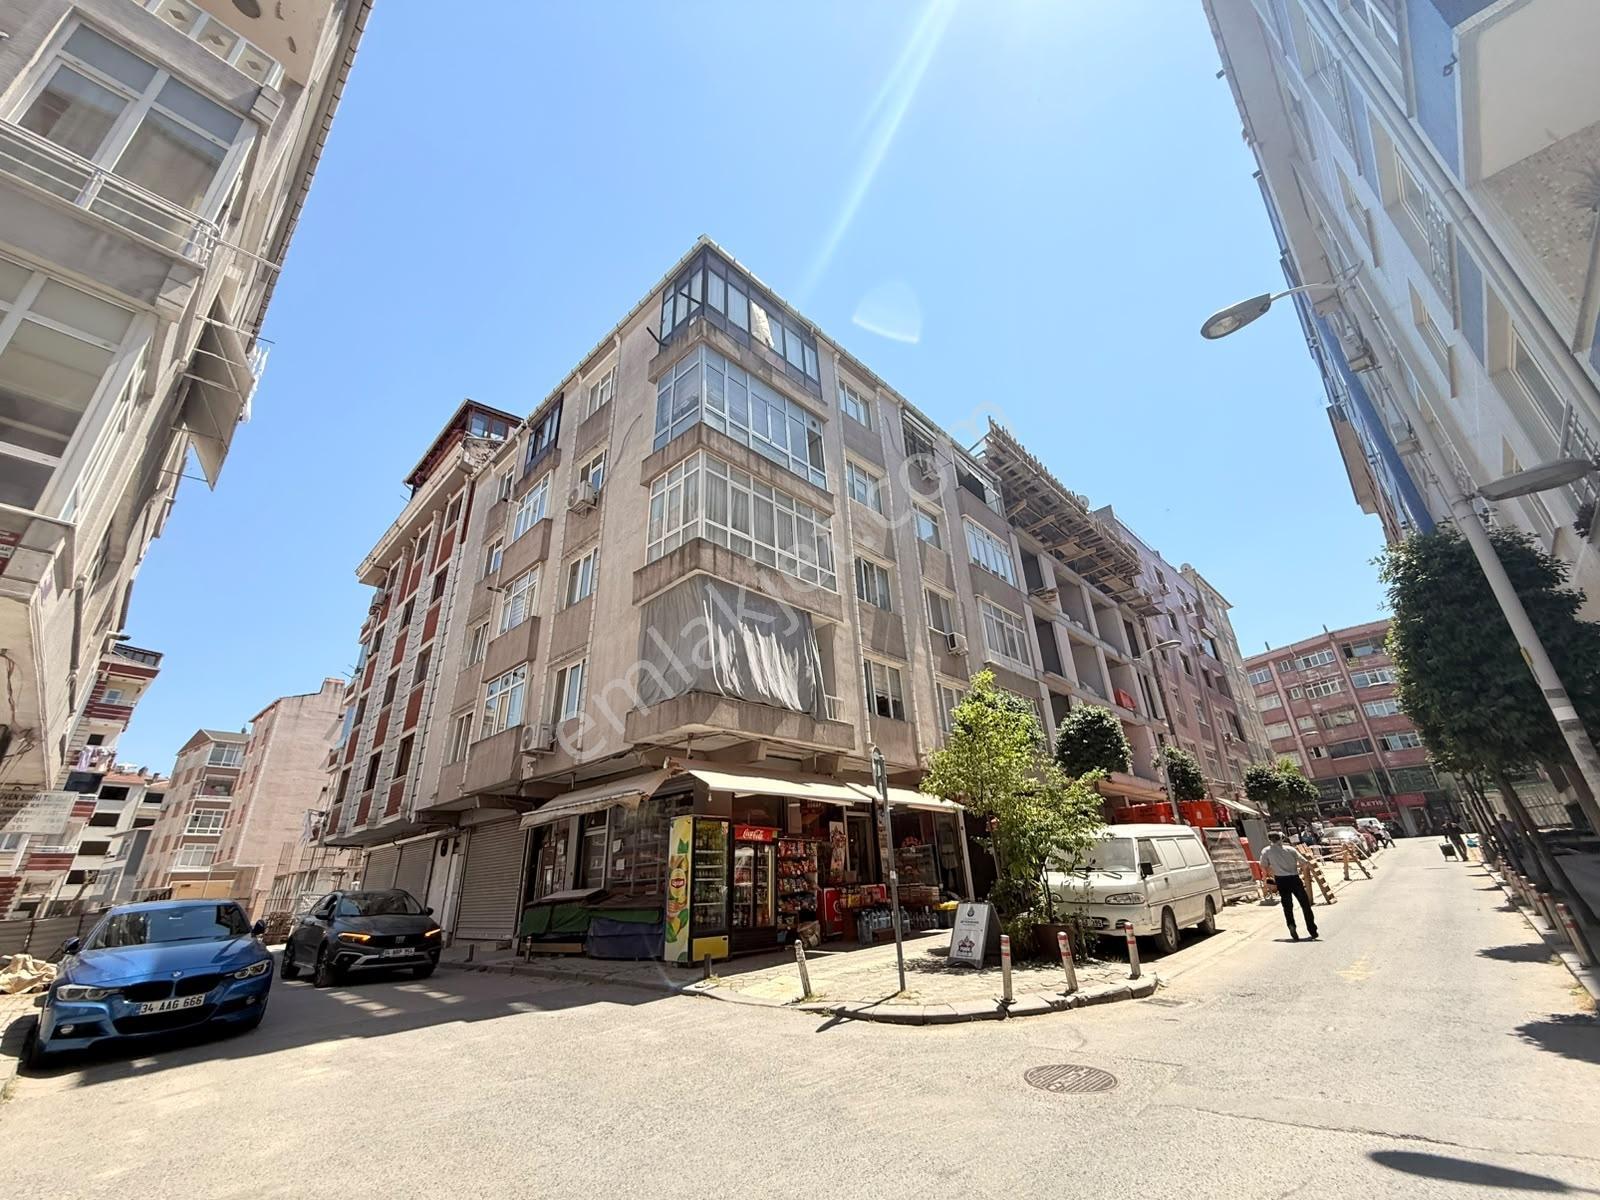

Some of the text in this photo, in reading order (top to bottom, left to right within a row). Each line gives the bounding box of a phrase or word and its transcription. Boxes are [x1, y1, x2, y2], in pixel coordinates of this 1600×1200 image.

[141, 996, 203, 1013] 34 AAG 666
